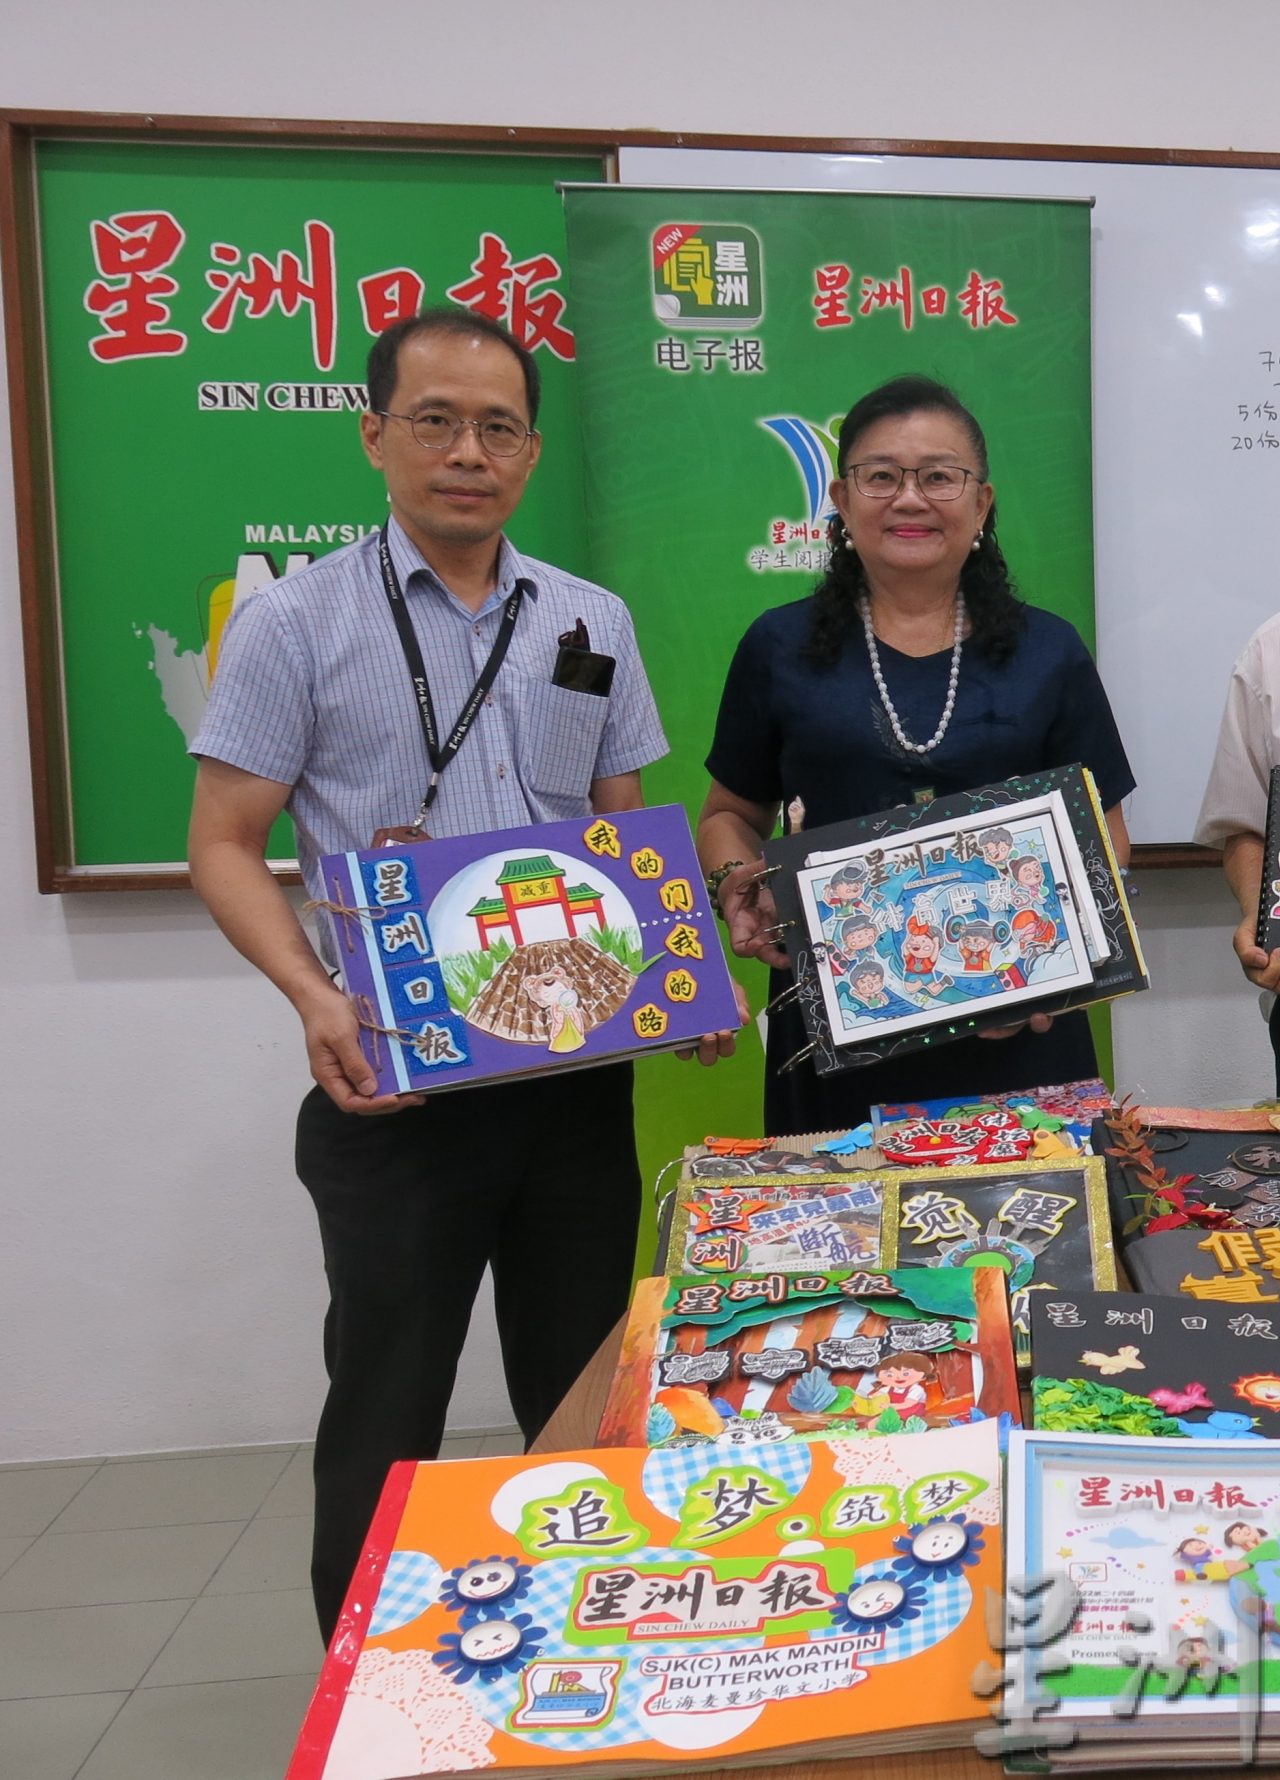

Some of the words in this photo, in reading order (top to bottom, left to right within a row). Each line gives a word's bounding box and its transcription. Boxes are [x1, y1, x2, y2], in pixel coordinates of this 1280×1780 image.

[656, 228, 683, 254] NEW
[714, 241, 749, 306] 星洲
[813, 264, 1018, 330] 星洲日報
[656, 337, 764, 372] 电子报
[199, 384, 257, 410] SIN
[583, 1571, 825, 1622] 星洲日報
[645, 1655, 723, 1674] SJK(C)
[729, 1646, 781, 1668] MAK
[788, 1634, 879, 1660] MANDIN
[668, 1656, 851, 1692] BUTTERWORTH
